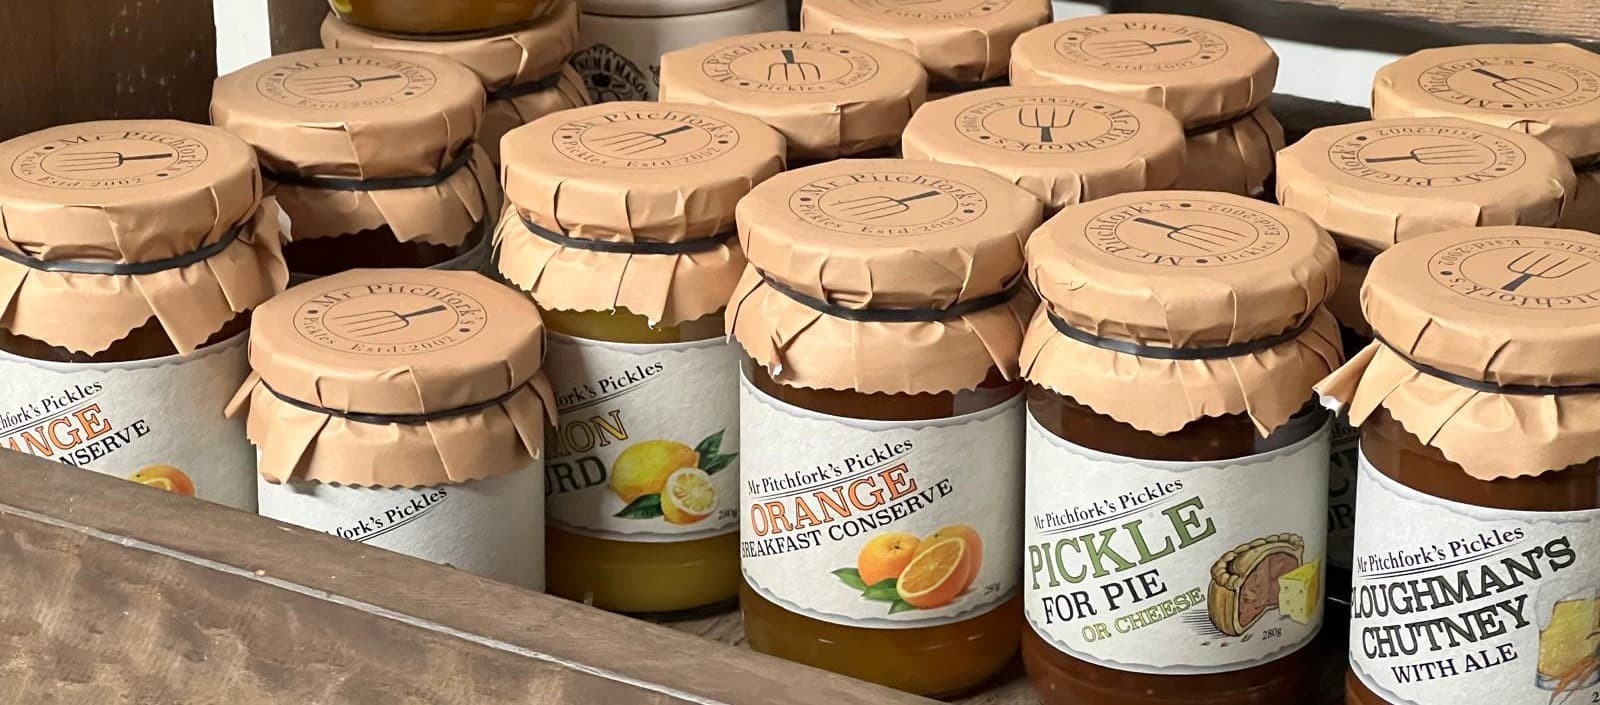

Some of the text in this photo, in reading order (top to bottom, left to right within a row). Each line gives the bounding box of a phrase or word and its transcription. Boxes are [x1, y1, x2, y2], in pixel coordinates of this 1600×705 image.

[59, 134, 105, 147] Mr
[603, 111, 735, 139] Pitchfork's
[563, 140, 607, 166] Pickles
[801, 172, 982, 209] Mr Pitchfork's
[801, 204, 841, 229] Pickles
[1090, 202, 1183, 267] Mr Pitchfork's
[312, 284, 485, 325] Mr Pitchfork's
[1450, 276, 1600, 308] itchfork's
[41, 381, 103, 413] Pickles
[598, 361, 664, 394] Pickles
[59, 419, 150, 468] NSERVE
[748, 439, 913, 496] Mr Pitchfork's Pickles
[325, 487, 448, 540] fork's Pickles
[750, 462, 918, 537] ORANGE
[828, 478, 953, 542] CONSERVE
[1046, 499, 1117, 526] Pitchfork's
[1119, 479, 1184, 511] Pickles
[1029, 495, 1217, 590] PICKLE
[1357, 527, 1524, 573] Mr Pitchfork's Pickles
[1042, 568, 1169, 625] FOR PIE
[1081, 587, 1206, 643] OR CHEESE
[1362, 594, 1530, 659] CHUTNEY
[1391, 642, 1518, 684] WITH ALE
